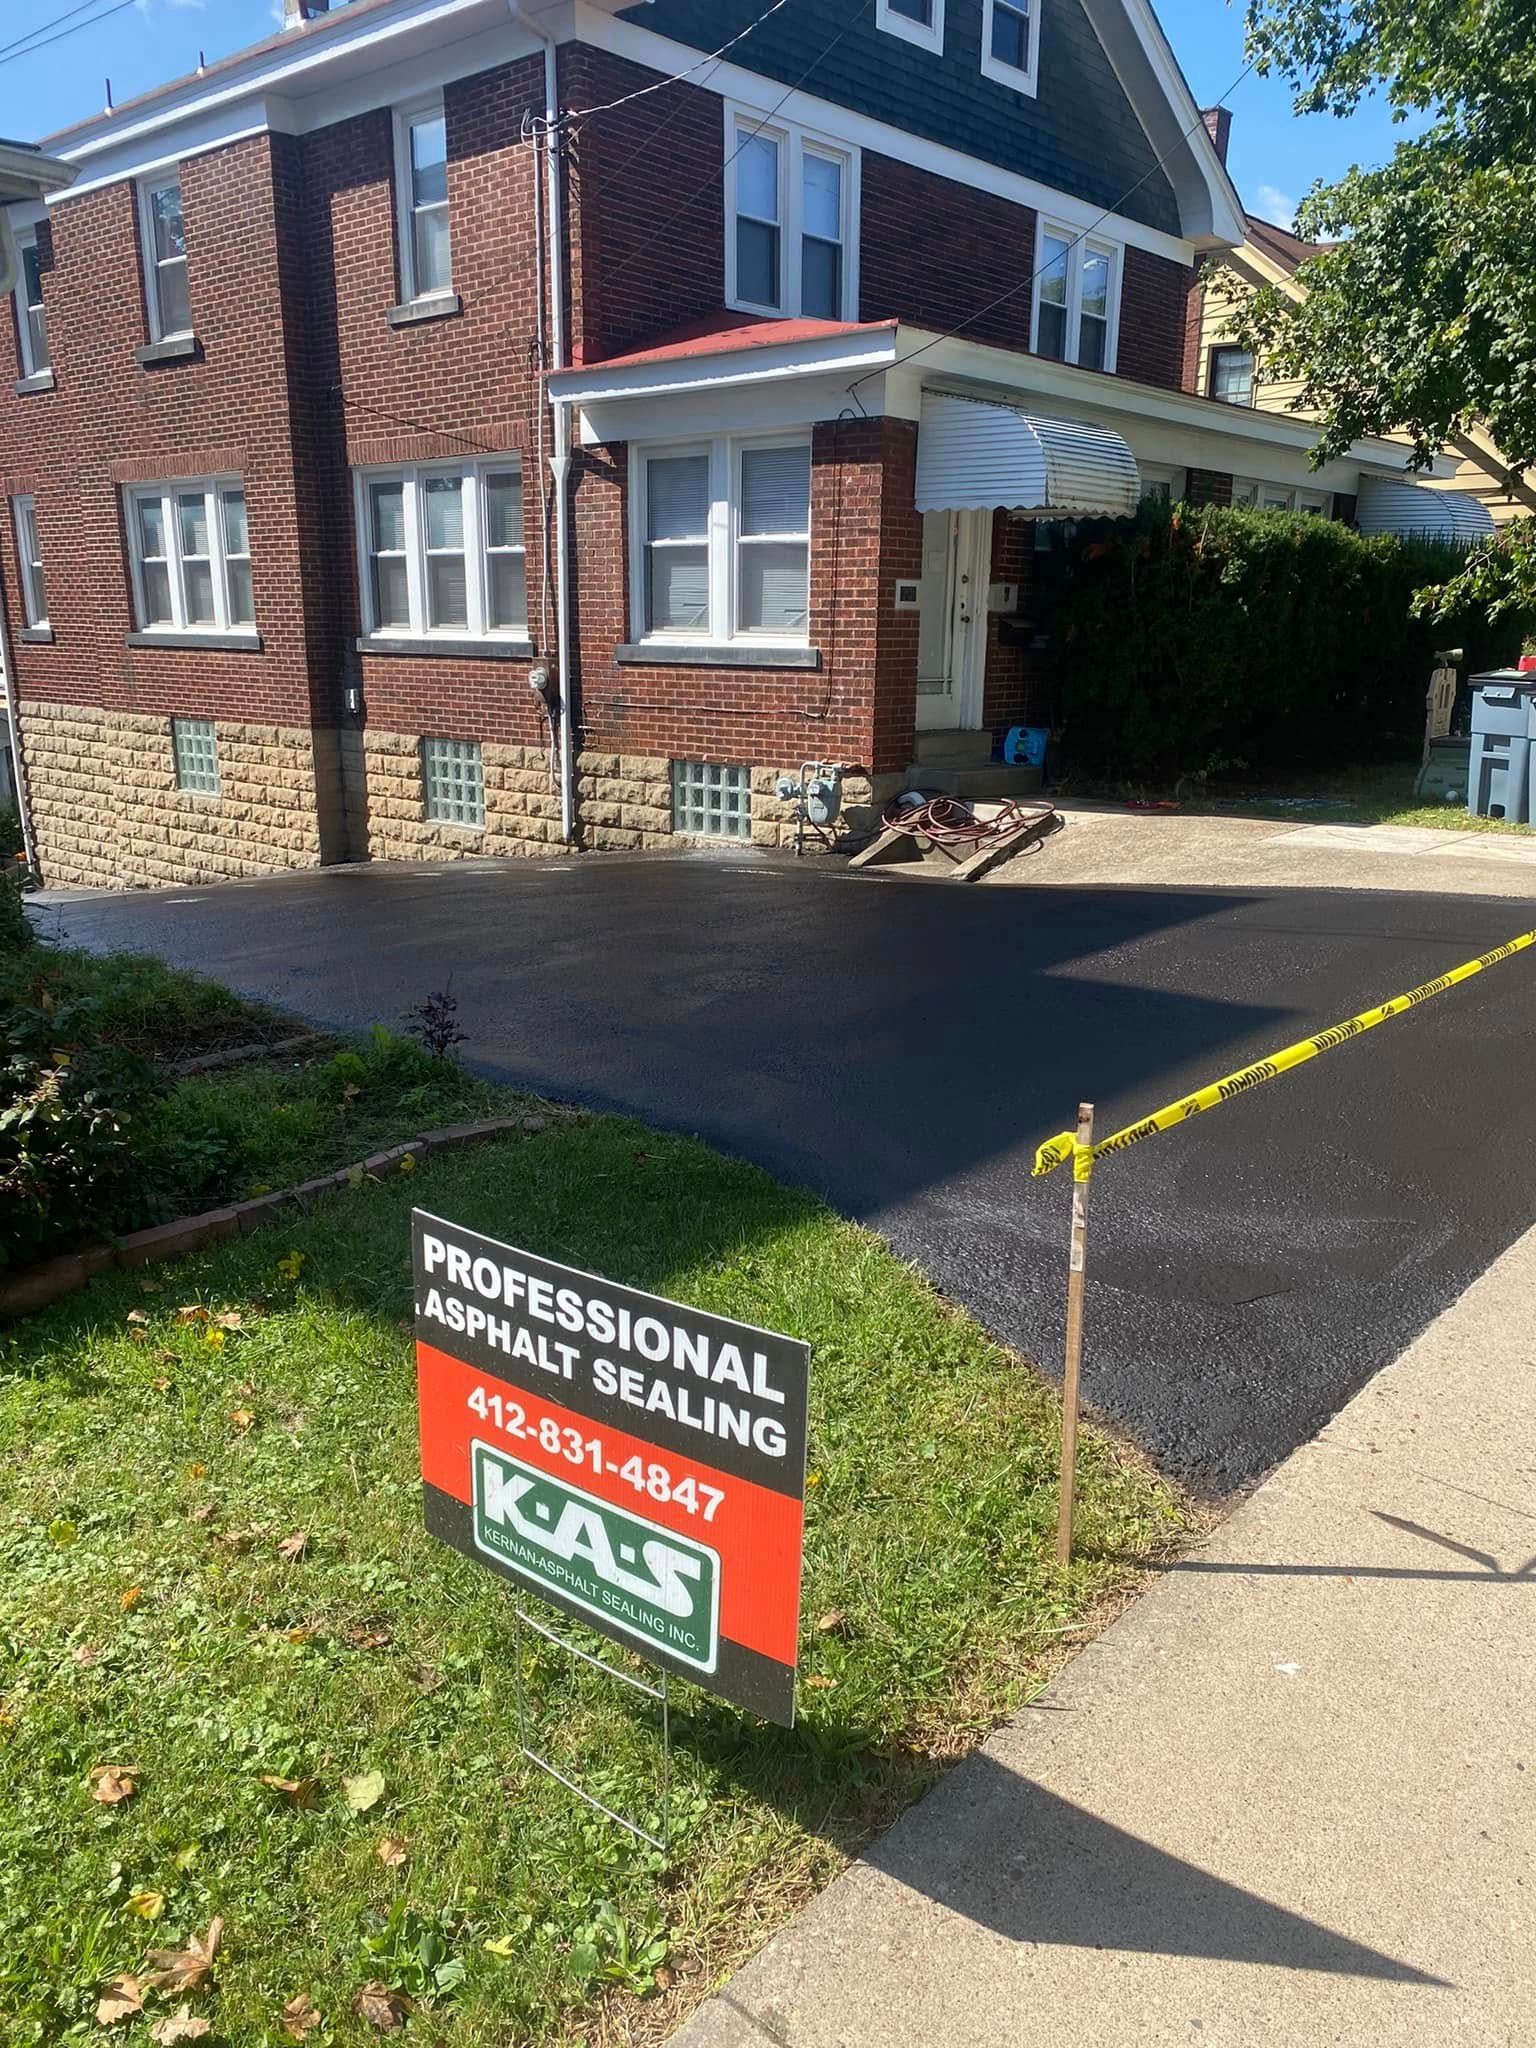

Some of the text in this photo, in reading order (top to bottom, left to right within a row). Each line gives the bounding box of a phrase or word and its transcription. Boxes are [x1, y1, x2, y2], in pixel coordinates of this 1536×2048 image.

[423, 1234, 784, 1404] PROFESSIONAL
[424, 1289, 786, 1457] ASPHALT SEALING
[467, 1386, 724, 1523] 412-831-4847
[484, 1526, 699, 1651] KERNAN-ASPHALT SEALING INC.
